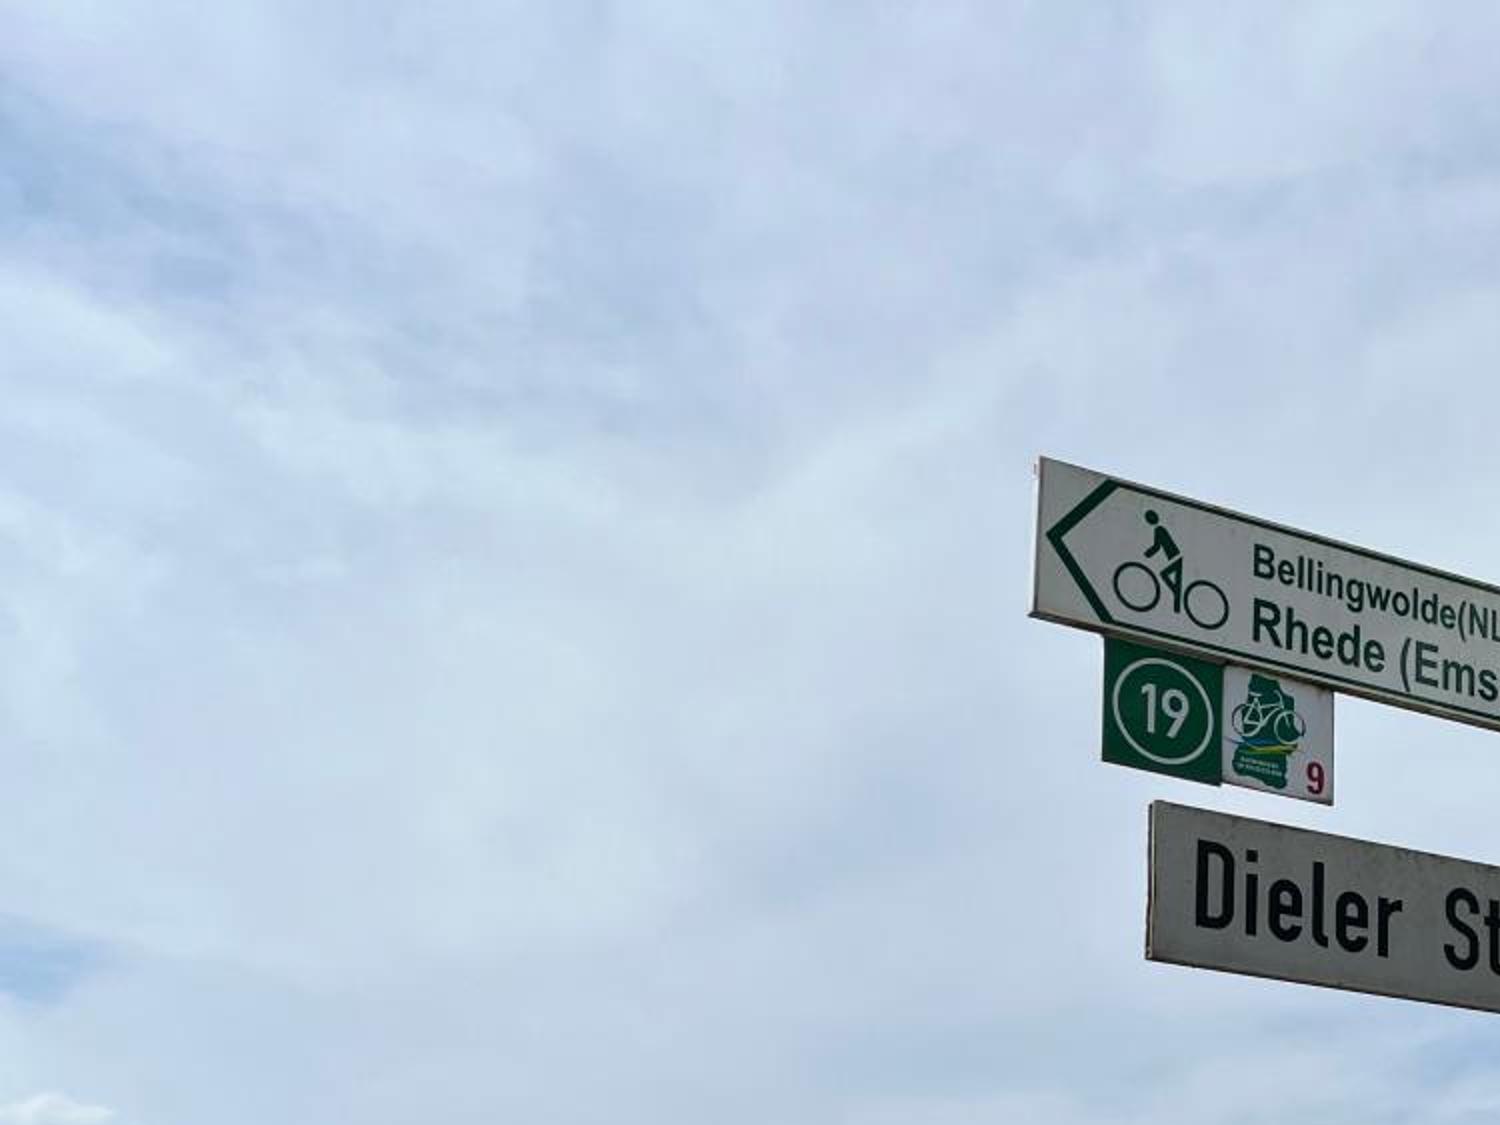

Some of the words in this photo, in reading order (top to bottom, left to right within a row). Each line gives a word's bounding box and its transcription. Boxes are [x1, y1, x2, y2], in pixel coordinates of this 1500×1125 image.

[1252, 597, 1385, 673] Rhede
[1140, 682, 1191, 739] 19
[1305, 760, 1326, 796] 9
[1195, 838, 1403, 959] Dieler
